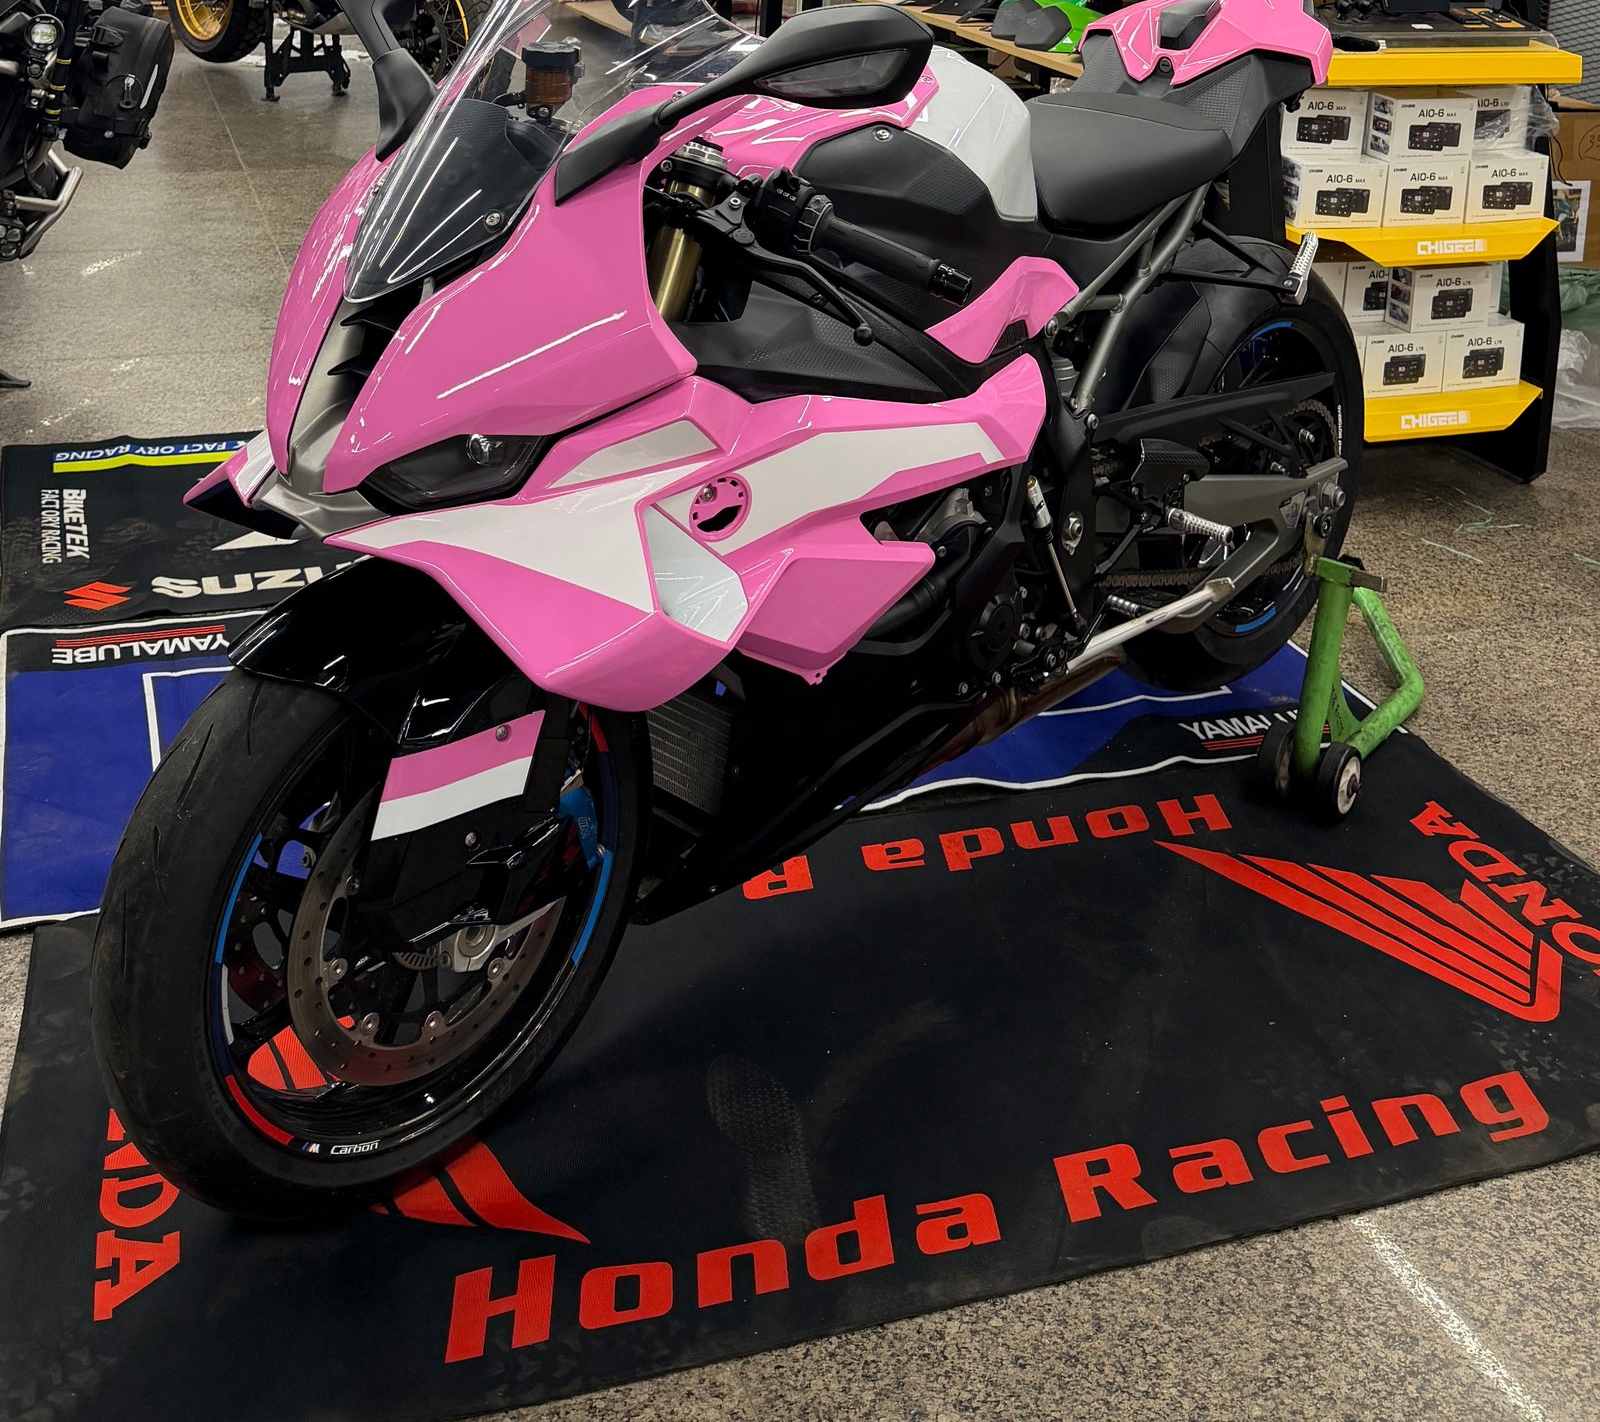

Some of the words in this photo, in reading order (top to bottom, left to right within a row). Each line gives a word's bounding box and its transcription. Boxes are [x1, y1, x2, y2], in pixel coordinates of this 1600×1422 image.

[1307, 101, 1334, 111] AIO-6
[1418, 108, 1445, 118] AIO-6
[1326, 174, 1353, 183] AIO-6
[1410, 172, 1436, 182] AIO-6
[1491, 168, 1517, 178] AIO-6
[1416, 239, 1475, 256] CHIGEE
[1436, 277, 1461, 287] AIO-6
[1388, 343, 1414, 353] AIO-6
[1467, 337, 1492, 347] AIO-6
[1400, 411, 1459, 429] CHIGEE
[55, 443, 131, 461] RACING
[62, 489, 90, 559] BIKETEK
[41, 529, 62, 564] RACING
[51, 632, 231, 664] YAMALUBE
[861, 794, 1232, 873] Honda
[1409, 799, 1600, 976] ONDA
[330, 1139, 381, 1156] Carbon
[444, 1193, 1001, 1364] Honda
[1053, 1070, 1550, 1223] Racing
